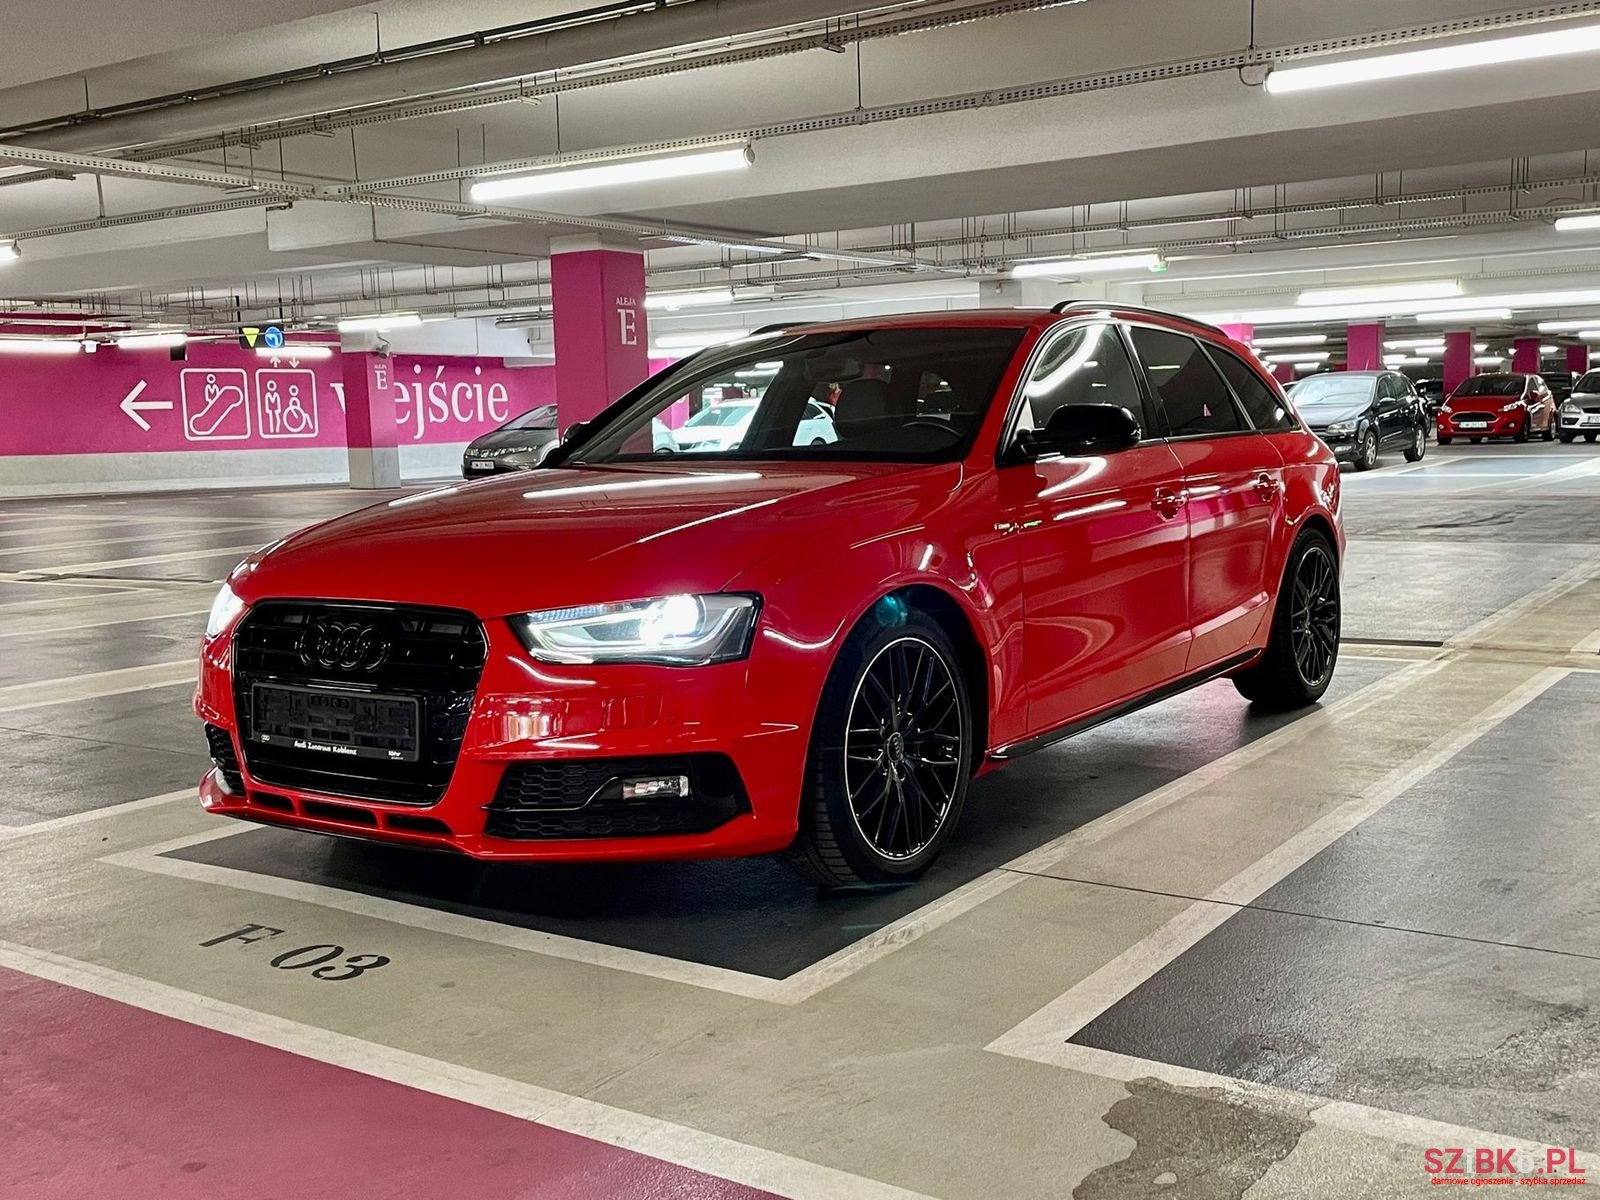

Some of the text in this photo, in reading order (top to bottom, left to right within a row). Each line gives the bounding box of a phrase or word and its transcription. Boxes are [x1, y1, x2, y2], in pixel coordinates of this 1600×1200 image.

[615, 296, 637, 306] ALEJA
[617, 308, 637, 345] E
[374, 370, 388, 390] E
[294, 740, 357, 755] Audi Zentrum Koblenz
[198, 923, 391, 981] F 03
